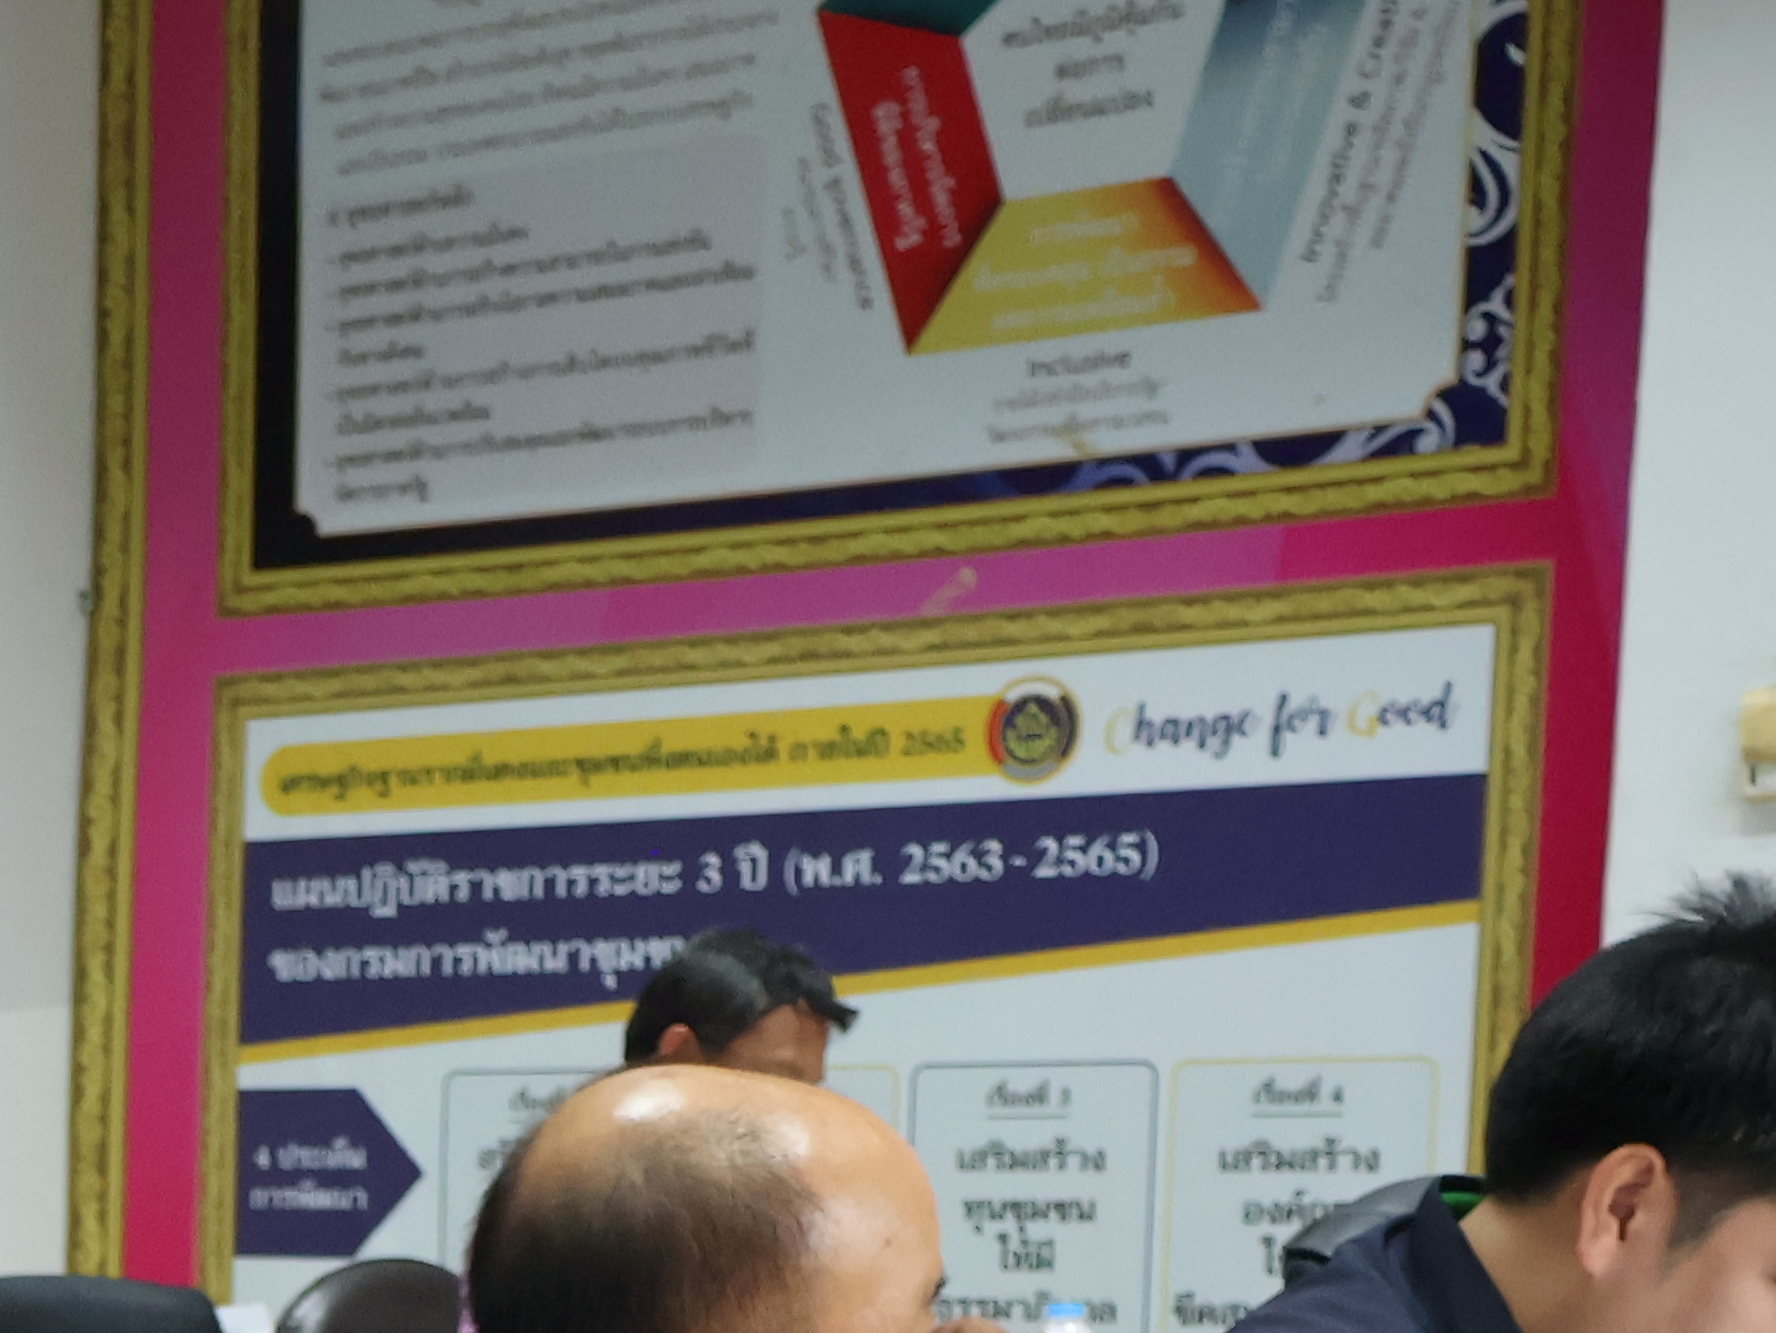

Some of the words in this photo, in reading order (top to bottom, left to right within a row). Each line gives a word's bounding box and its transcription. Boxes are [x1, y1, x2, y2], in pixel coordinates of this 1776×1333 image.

[1027, 351, 1131, 378] Inclusive
[1104, 699, 1257, 760] Change
[1270, 690, 1334, 758] for
[1345, 679, 1454, 740] Good
[270, 856, 682, 918] แผนปฏิบัติราชการระยะ
[695, 851, 723, 894] 3
[734, 839, 770, 892] ปี
[784, 845, 884, 896] (พ.ศ.
[956, 1138, 1108, 1172] เสริมสร้าง
[1218, 1137, 1381, 1173] เสริมสร้าง
[964, 1198, 1098, 1236] ทุนชุมชน
